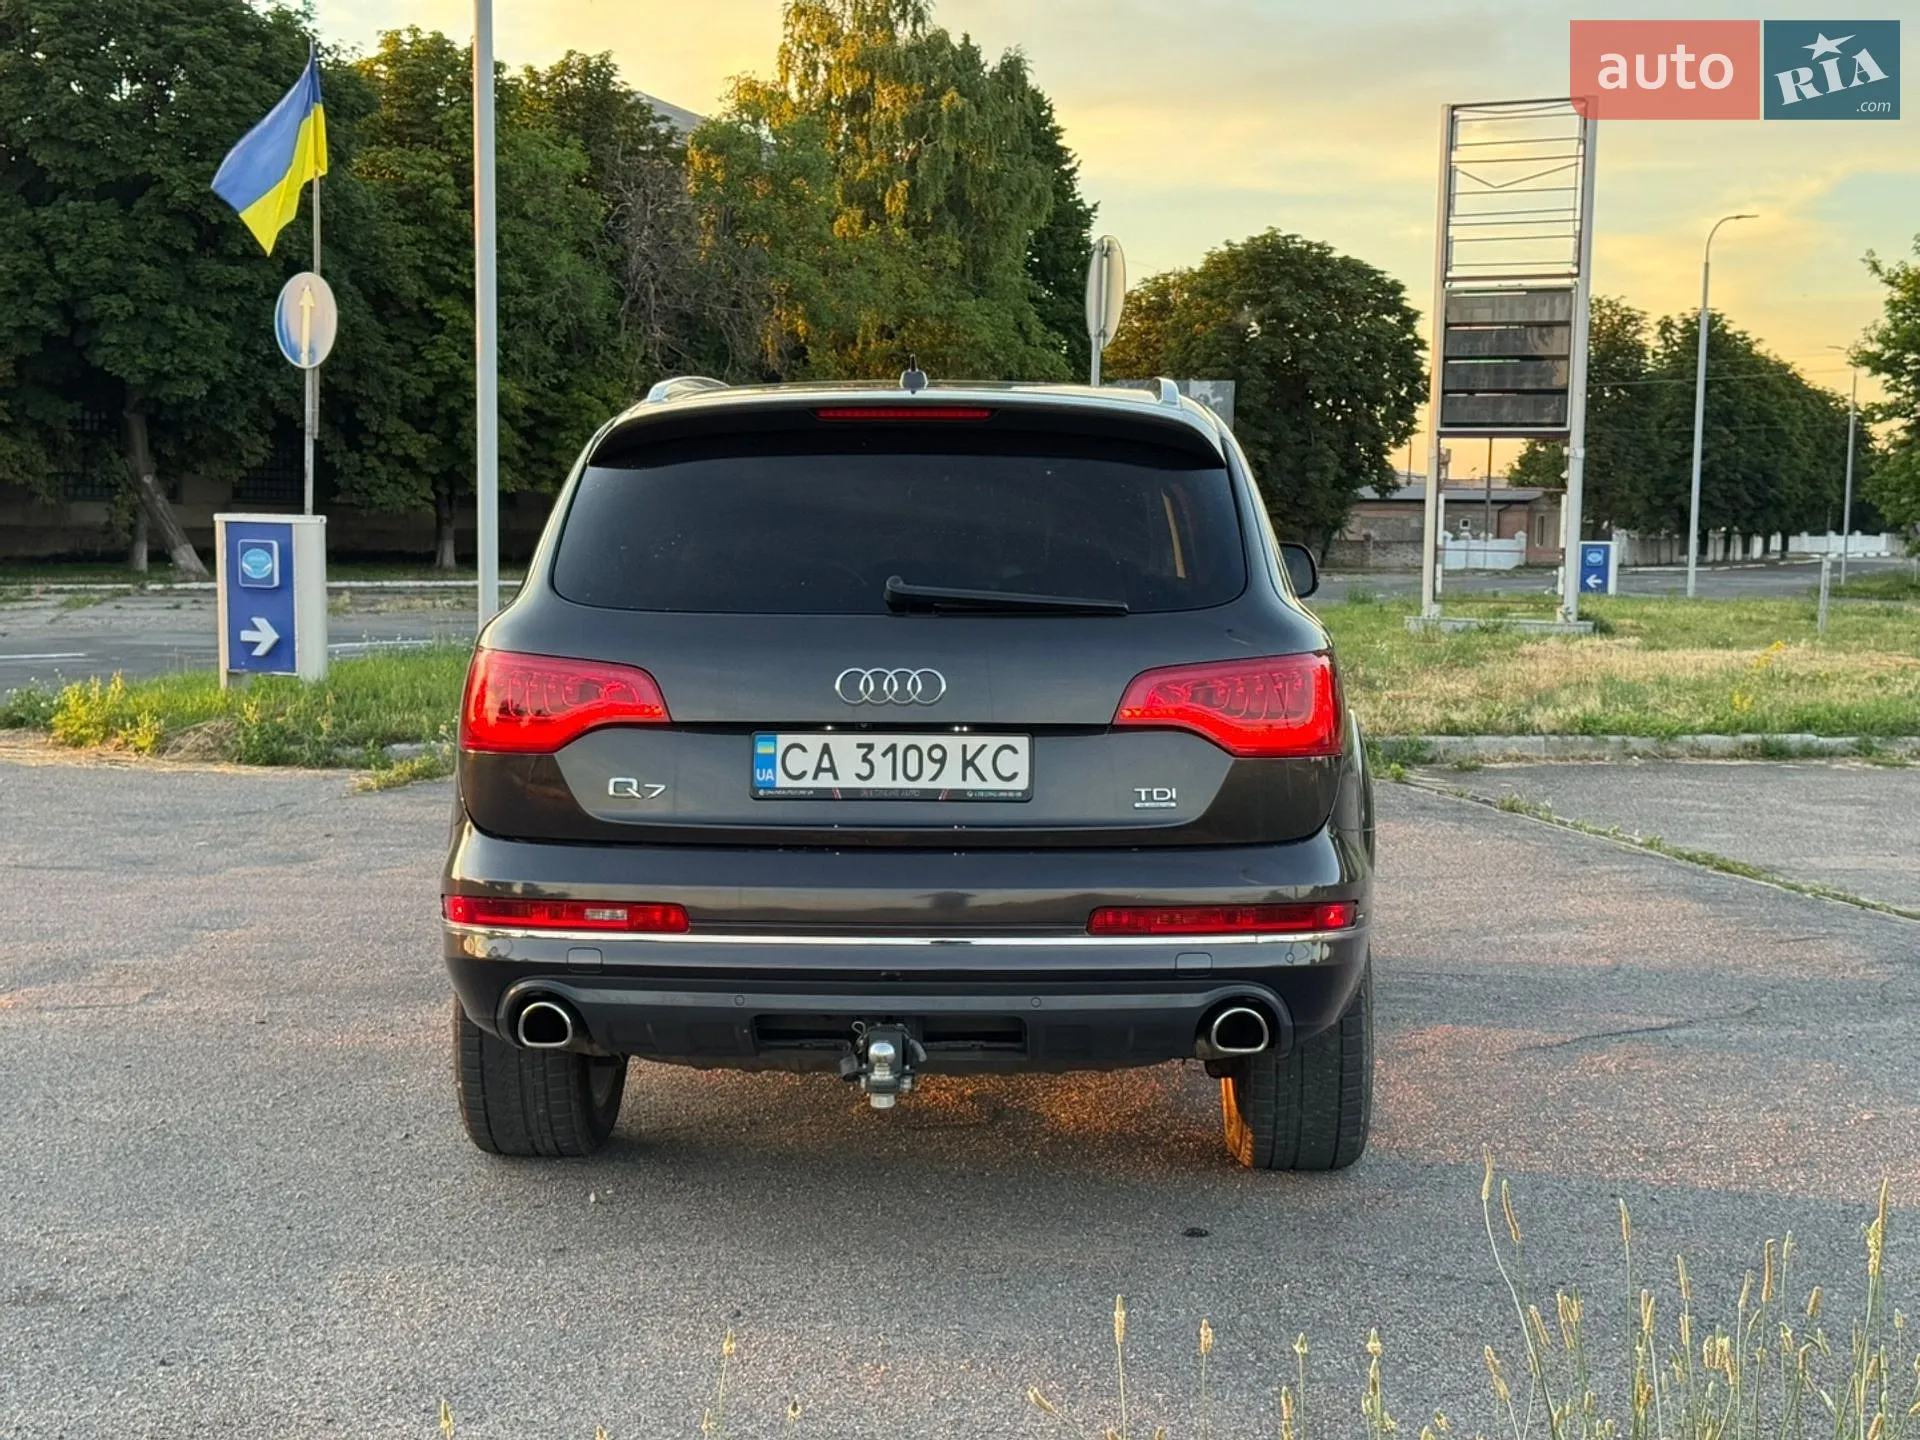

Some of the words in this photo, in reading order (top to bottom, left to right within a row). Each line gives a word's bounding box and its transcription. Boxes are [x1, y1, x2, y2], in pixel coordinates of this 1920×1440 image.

[780, 742, 840, 781] CA
[854, 743, 947, 782] 3109
[961, 743, 1019, 782] KC
[756, 768, 774, 781] UA
[608, 777, 666, 799] Q7
[1134, 787, 1176, 801] TDI
